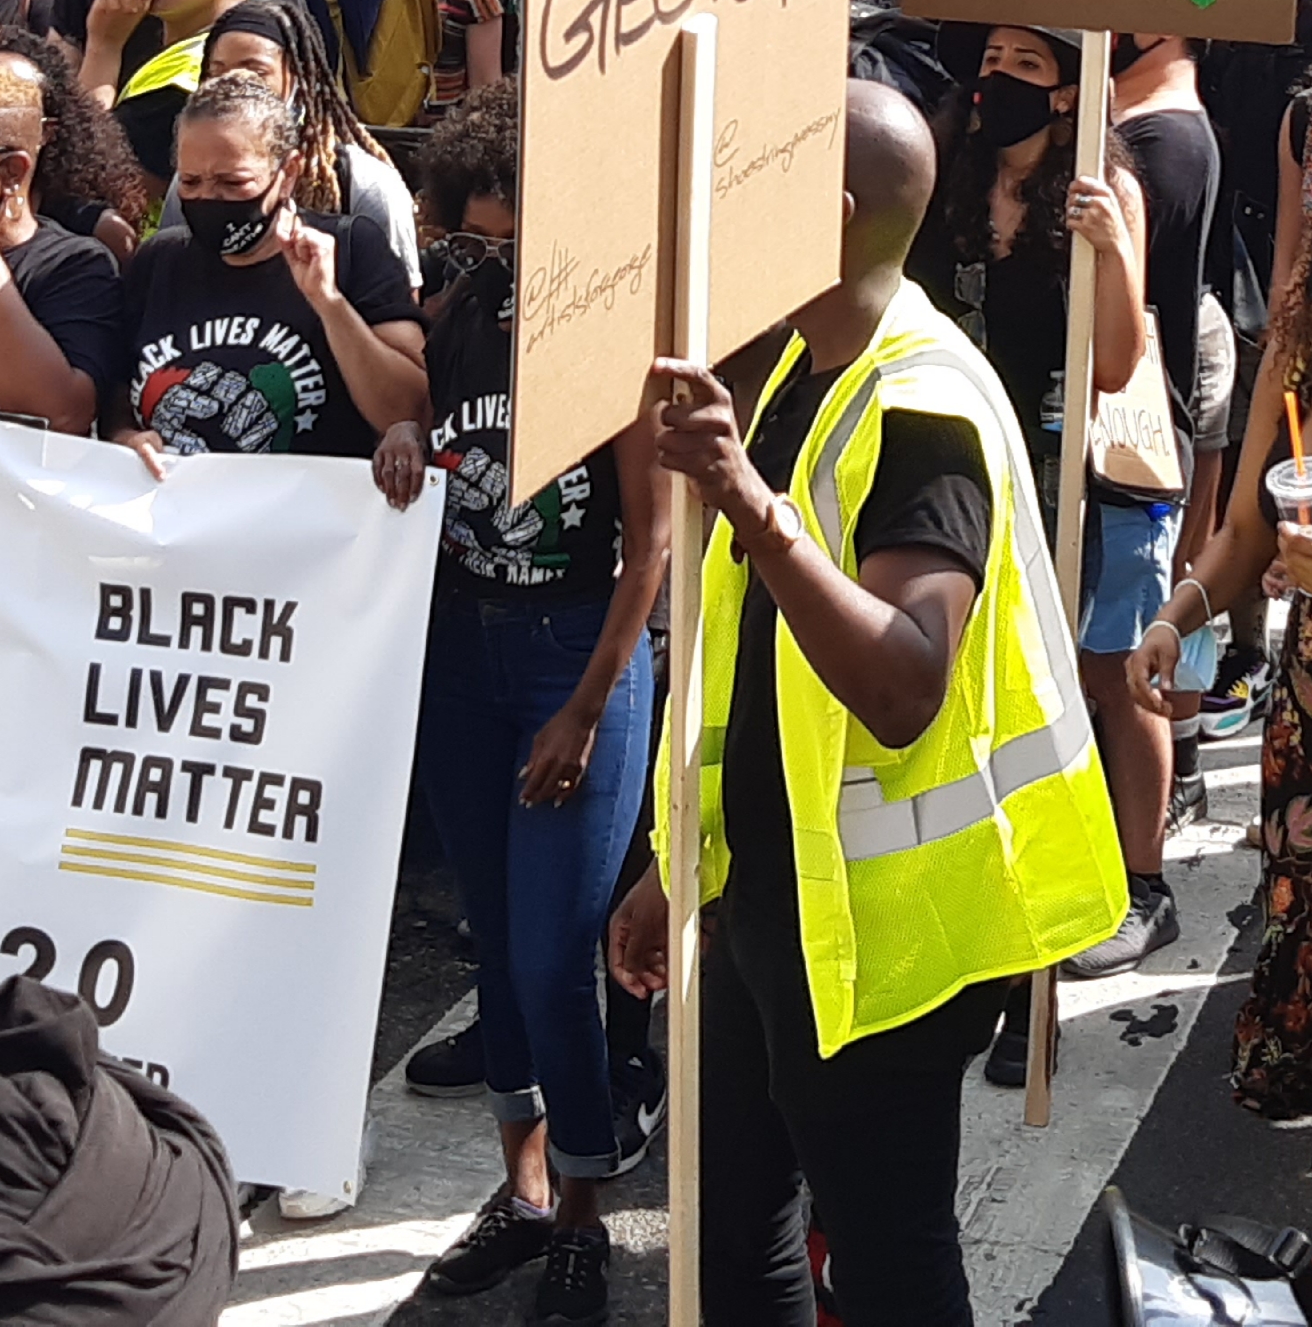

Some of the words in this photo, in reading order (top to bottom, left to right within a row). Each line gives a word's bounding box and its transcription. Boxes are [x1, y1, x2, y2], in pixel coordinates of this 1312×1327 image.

[189, 316, 261, 350] LIVES
[259, 322, 327, 409] MATTER
[95, 582, 299, 664] BLACK
[83, 662, 271, 746] LIVES
[71, 746, 323, 844] MATTER
